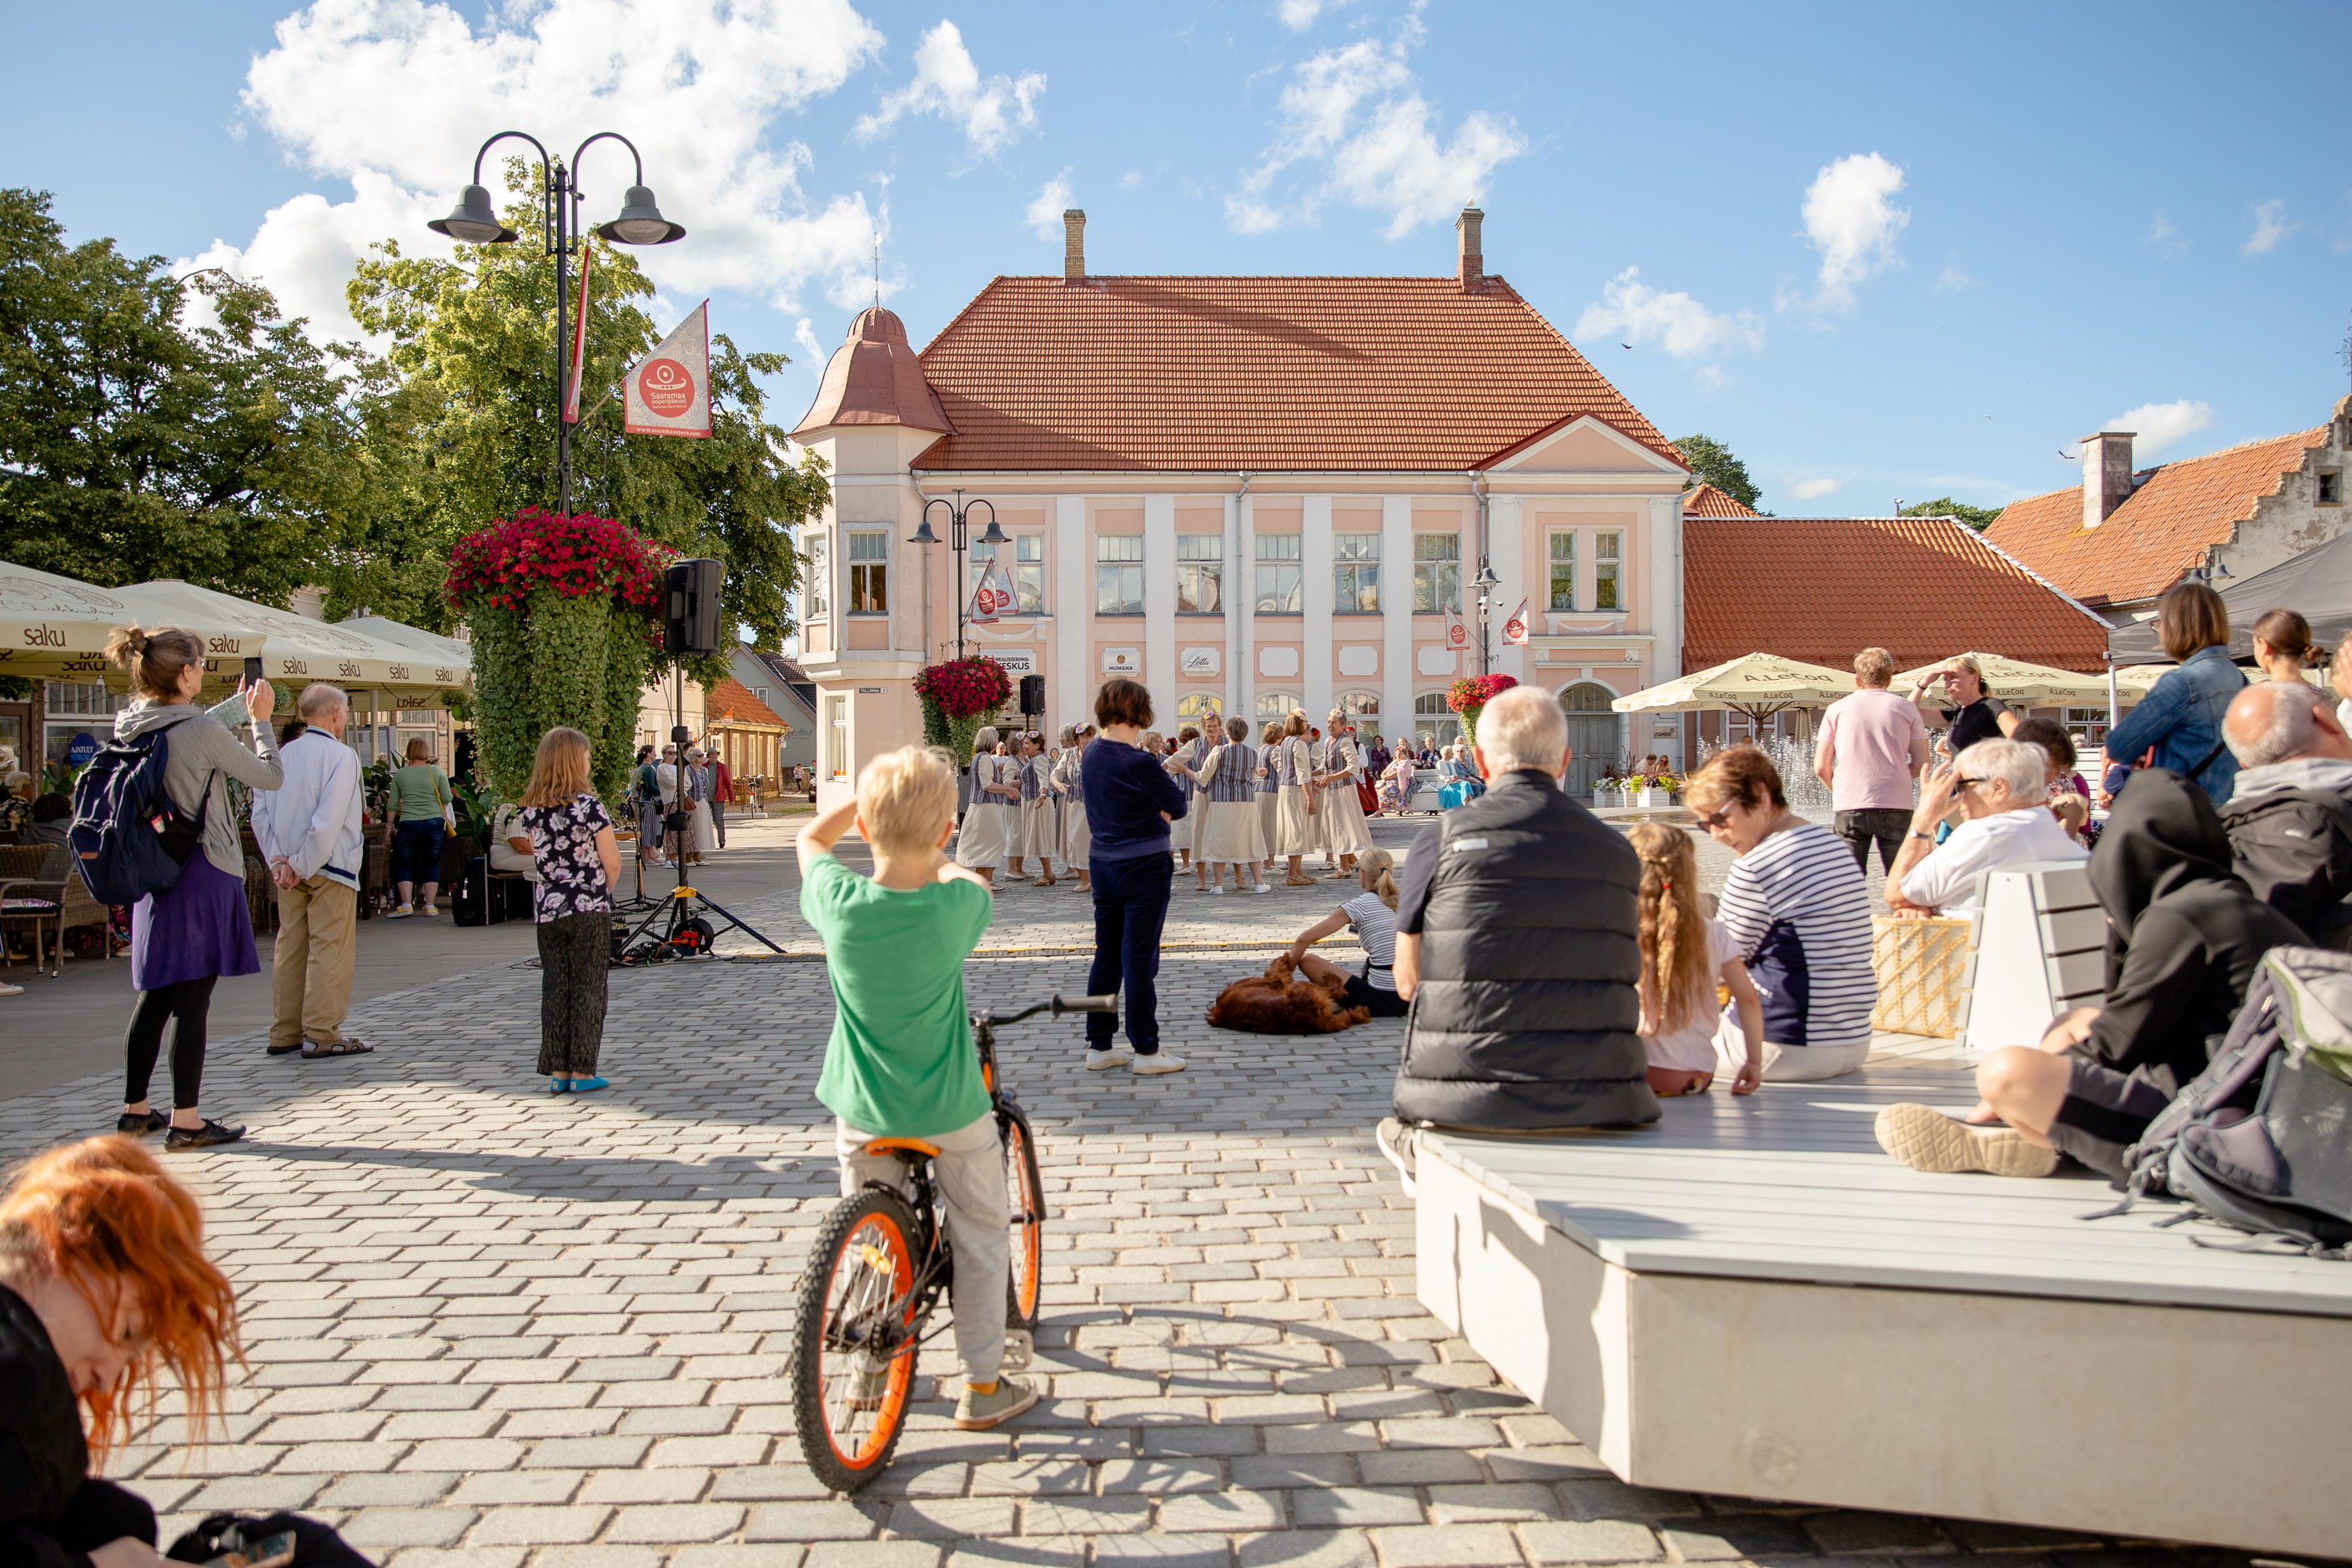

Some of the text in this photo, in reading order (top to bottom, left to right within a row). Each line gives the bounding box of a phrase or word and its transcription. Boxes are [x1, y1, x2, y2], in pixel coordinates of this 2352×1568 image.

[636, 427, 701, 436] www.saaremaaopera.com
[23, 623, 67, 647] saku
[209, 633, 240, 654] saku
[283, 656, 308, 675] saku
[339, 659, 361, 678] saku
[1188, 656, 1209, 668] Lotta
[389, 663, 410, 680] saku
[435, 666, 453, 682] saku
